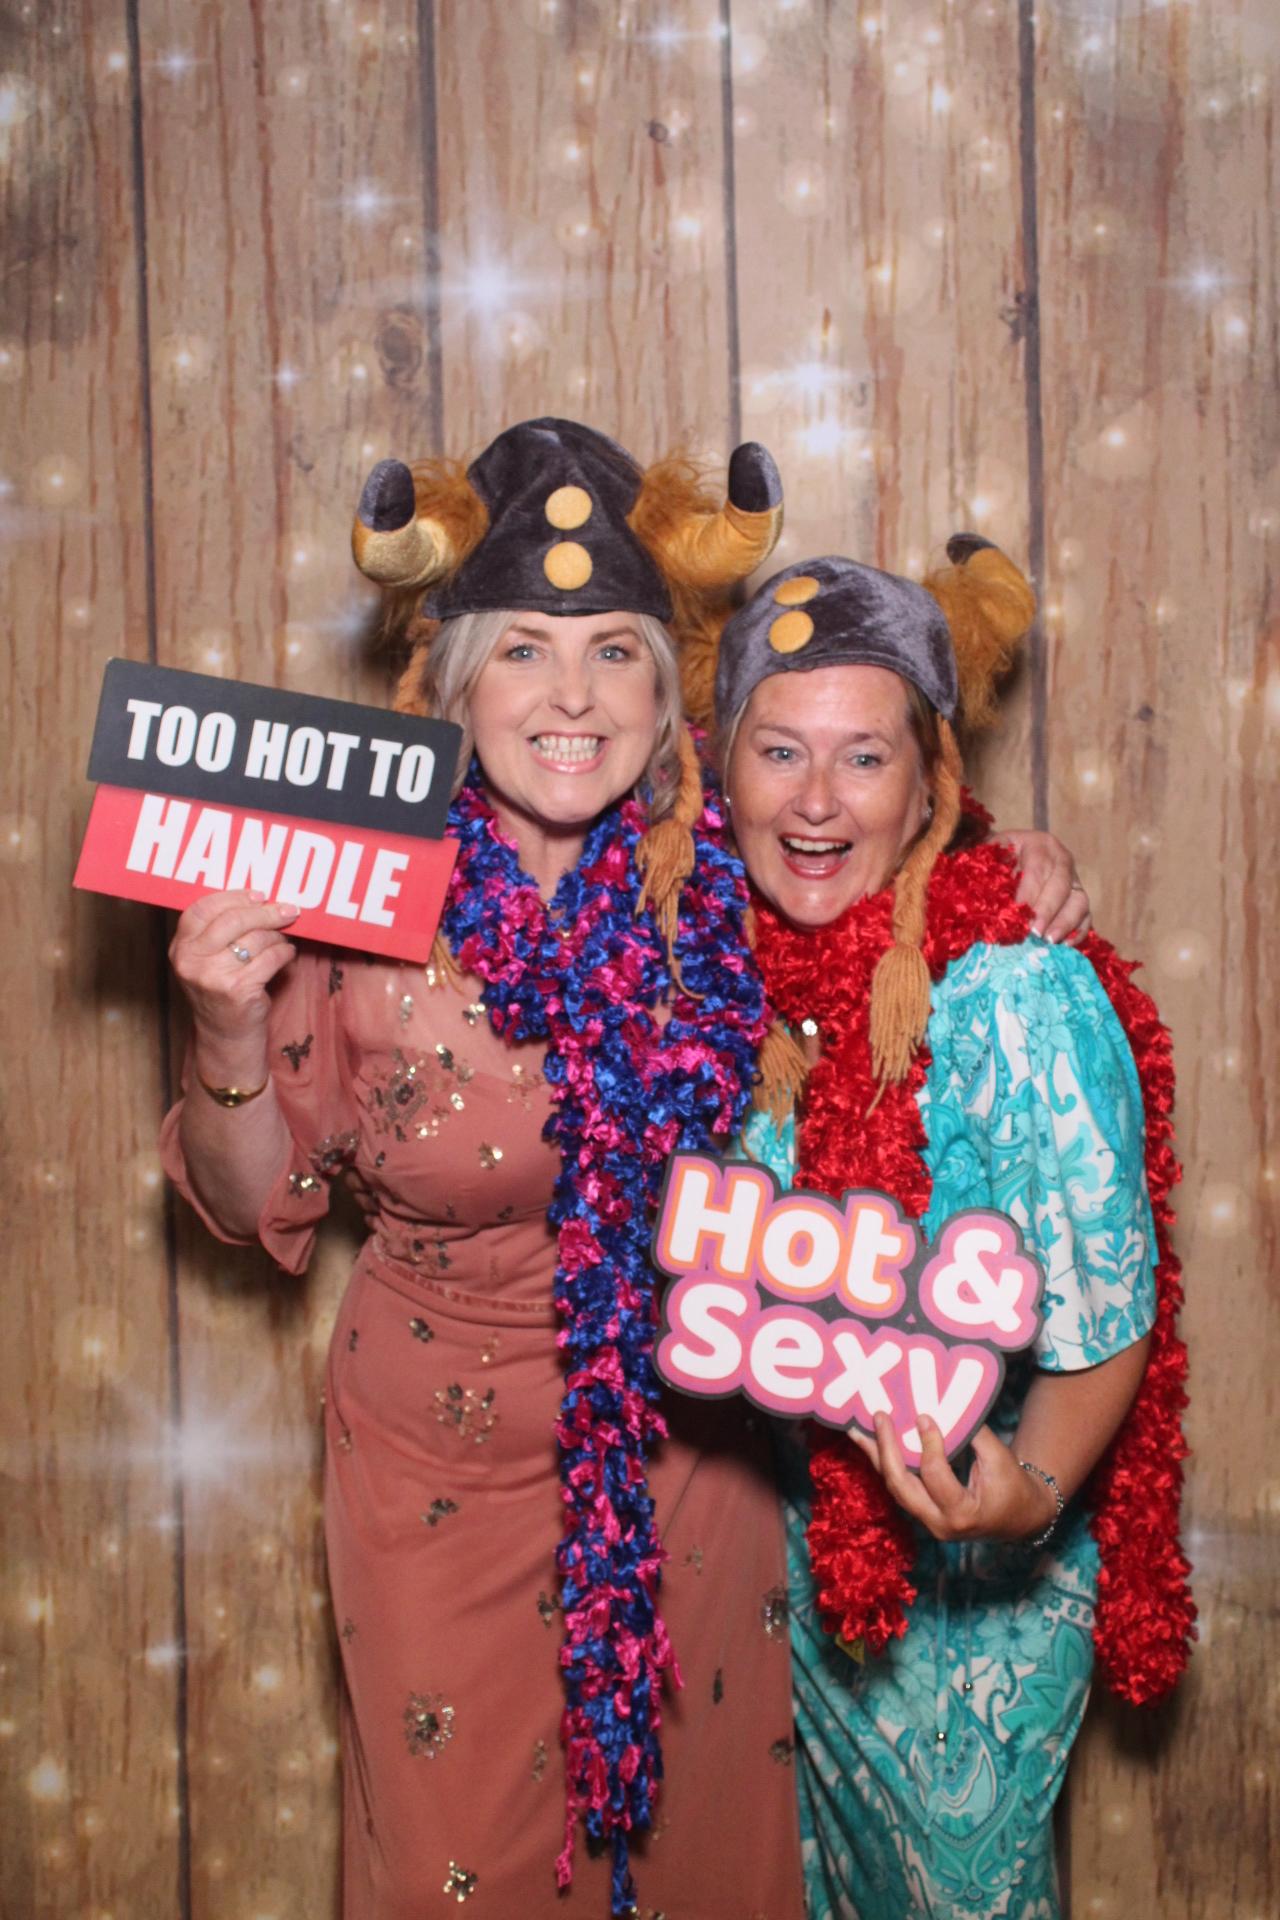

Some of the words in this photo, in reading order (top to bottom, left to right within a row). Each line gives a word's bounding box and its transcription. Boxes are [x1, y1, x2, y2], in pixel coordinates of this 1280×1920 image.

[126, 699, 237, 773] TOO
[244, 719, 360, 786] HOT
[368, 738, 436, 803] TO
[125, 794, 410, 928] HANDLE
[669, 1169, 901, 1304] Hot
[931, 1228, 1024, 1332] &
[670, 1283, 984, 1453] Sexy
